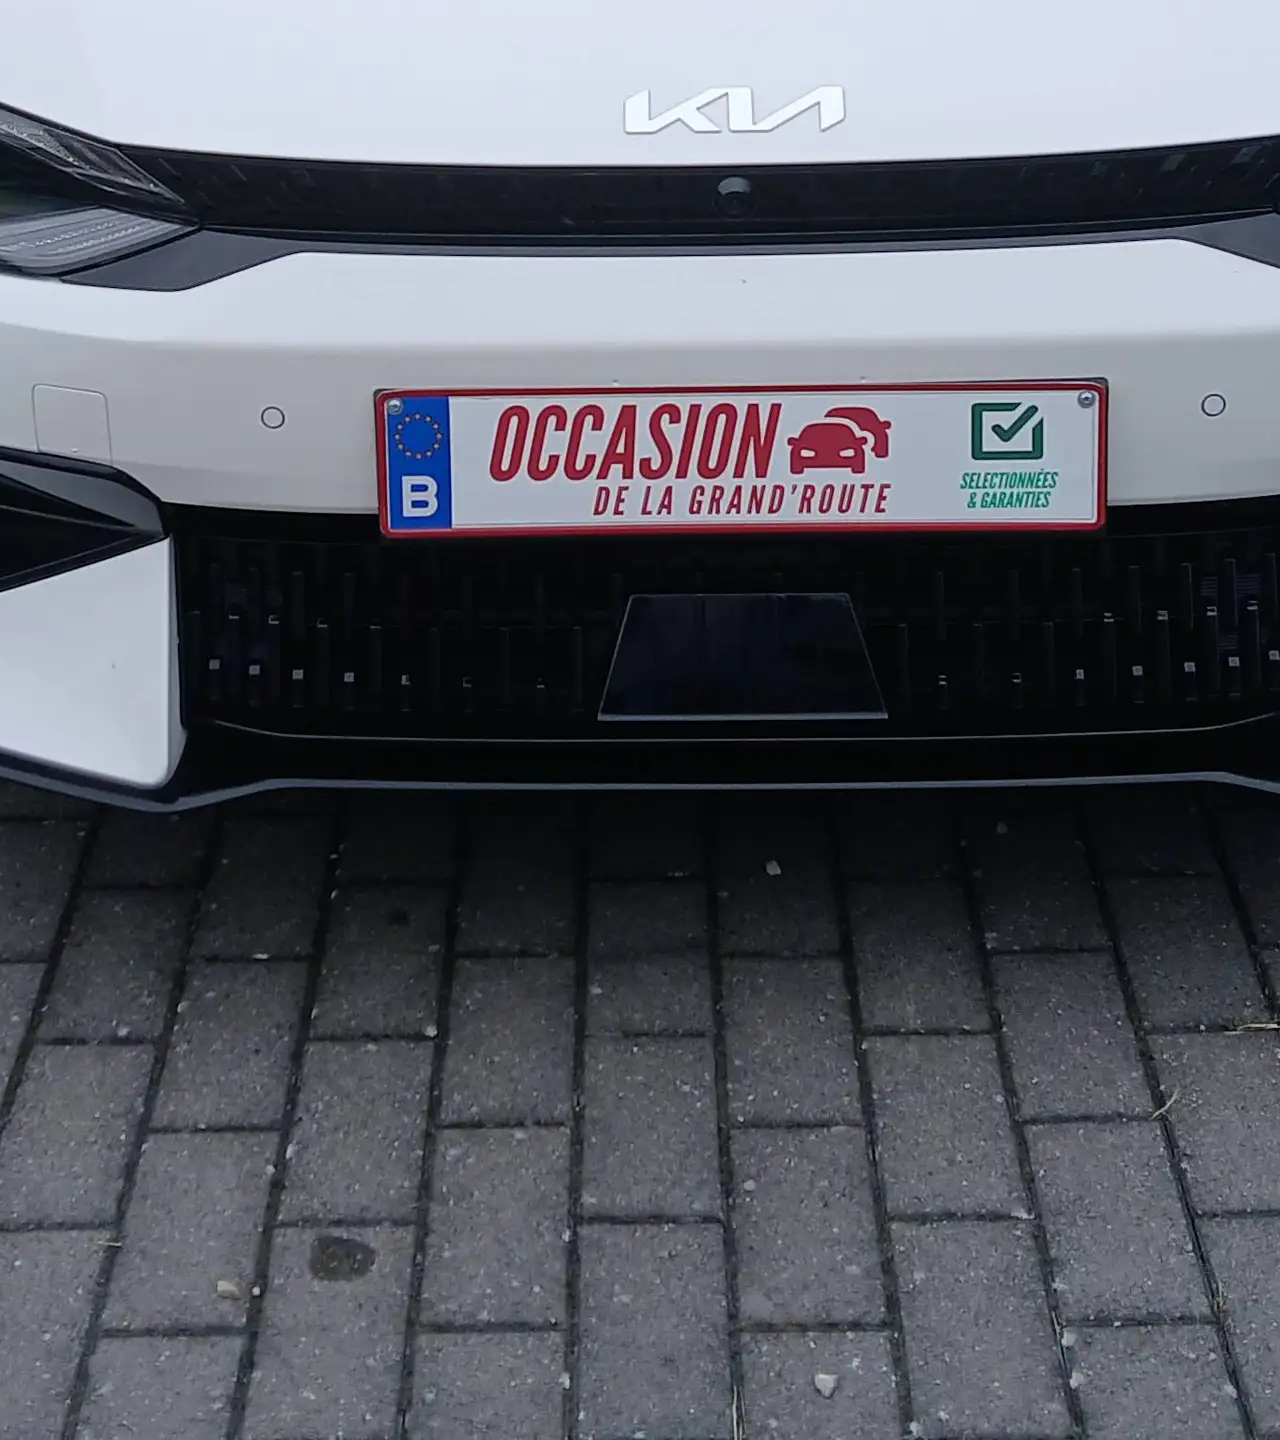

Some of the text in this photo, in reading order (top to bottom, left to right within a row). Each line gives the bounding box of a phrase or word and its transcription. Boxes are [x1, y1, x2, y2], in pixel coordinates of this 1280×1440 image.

[624, 85, 847, 135] KIA
[489, 403, 782, 482] OCCASION
[401, 475, 439, 517] B
[592, 483, 892, 516] DE LA GRAND'ROUTE
[967, 491, 1051, 509] & GARANTIES
